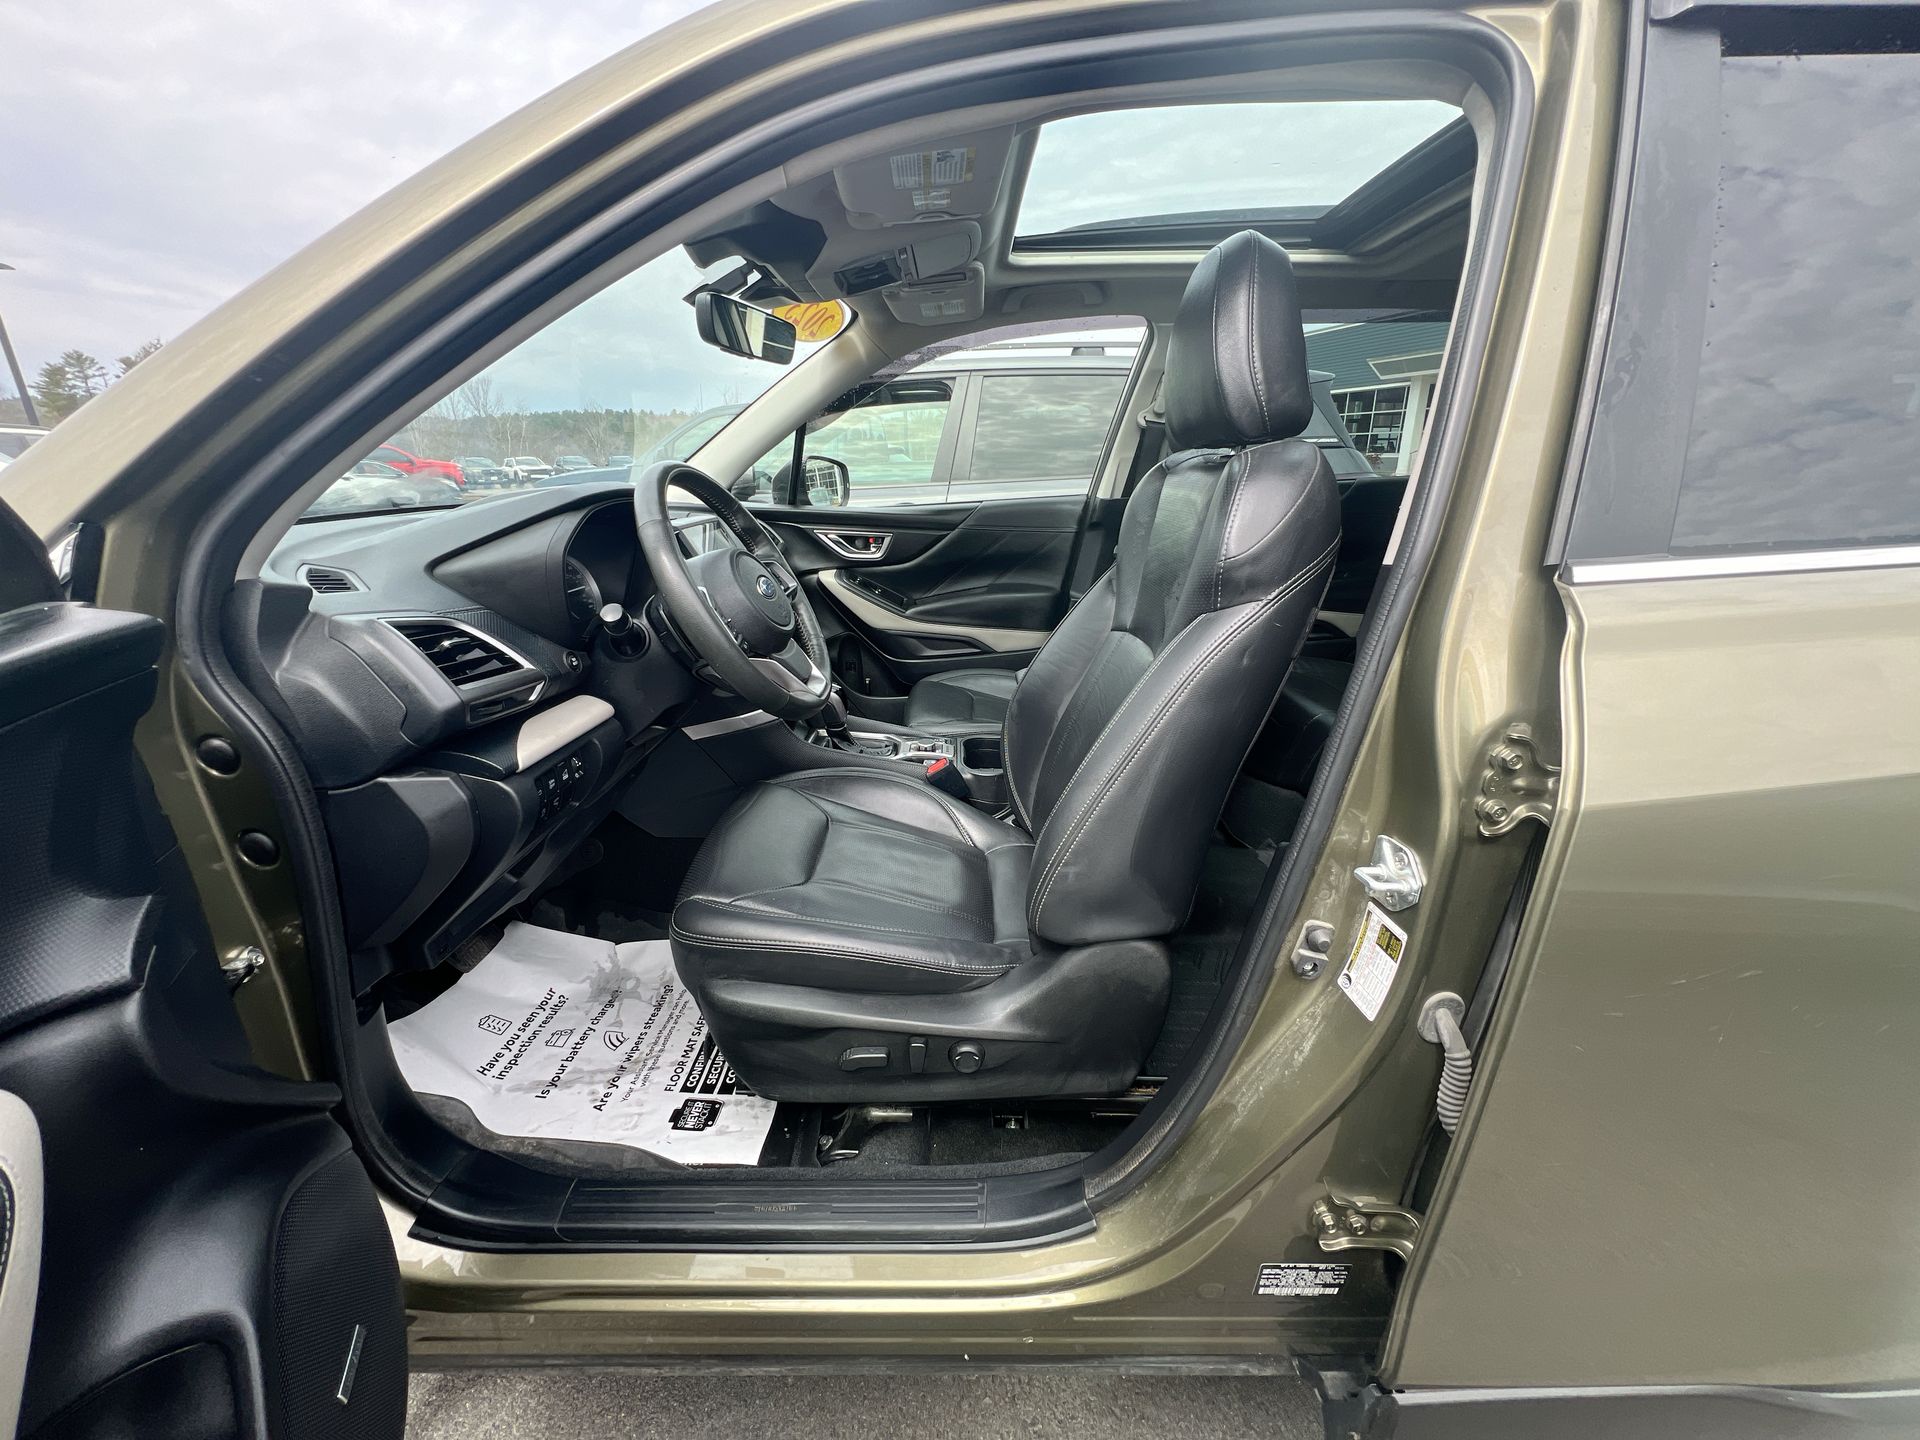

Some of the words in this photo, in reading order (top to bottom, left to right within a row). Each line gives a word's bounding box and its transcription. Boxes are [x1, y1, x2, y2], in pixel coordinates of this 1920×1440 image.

[476, 1050, 505, 1076] Have
[500, 1033, 521, 1052] you
[517, 1011, 540, 1032] seen
[535, 987, 557, 1012] your
[492, 1029, 543, 1080] inspection
[539, 994, 569, 1032] results?
[535, 1088, 550, 1099] Is
[547, 1063, 568, 1090] your
[561, 1026, 597, 1063] battery
[590, 987, 623, 1026] charged?
[593, 1090, 613, 1112] Are
[623, 1031, 648, 1063] wipers
[643, 984, 674, 1031] streaking?
[664, 1060, 688, 1092] FLOOR
[681, 1038, 698, 1059] MAT
[677, 1106, 692, 1127] SECURE
[684, 1101, 704, 1129] NEVER
[694, 1108, 710, 1129] STACK
